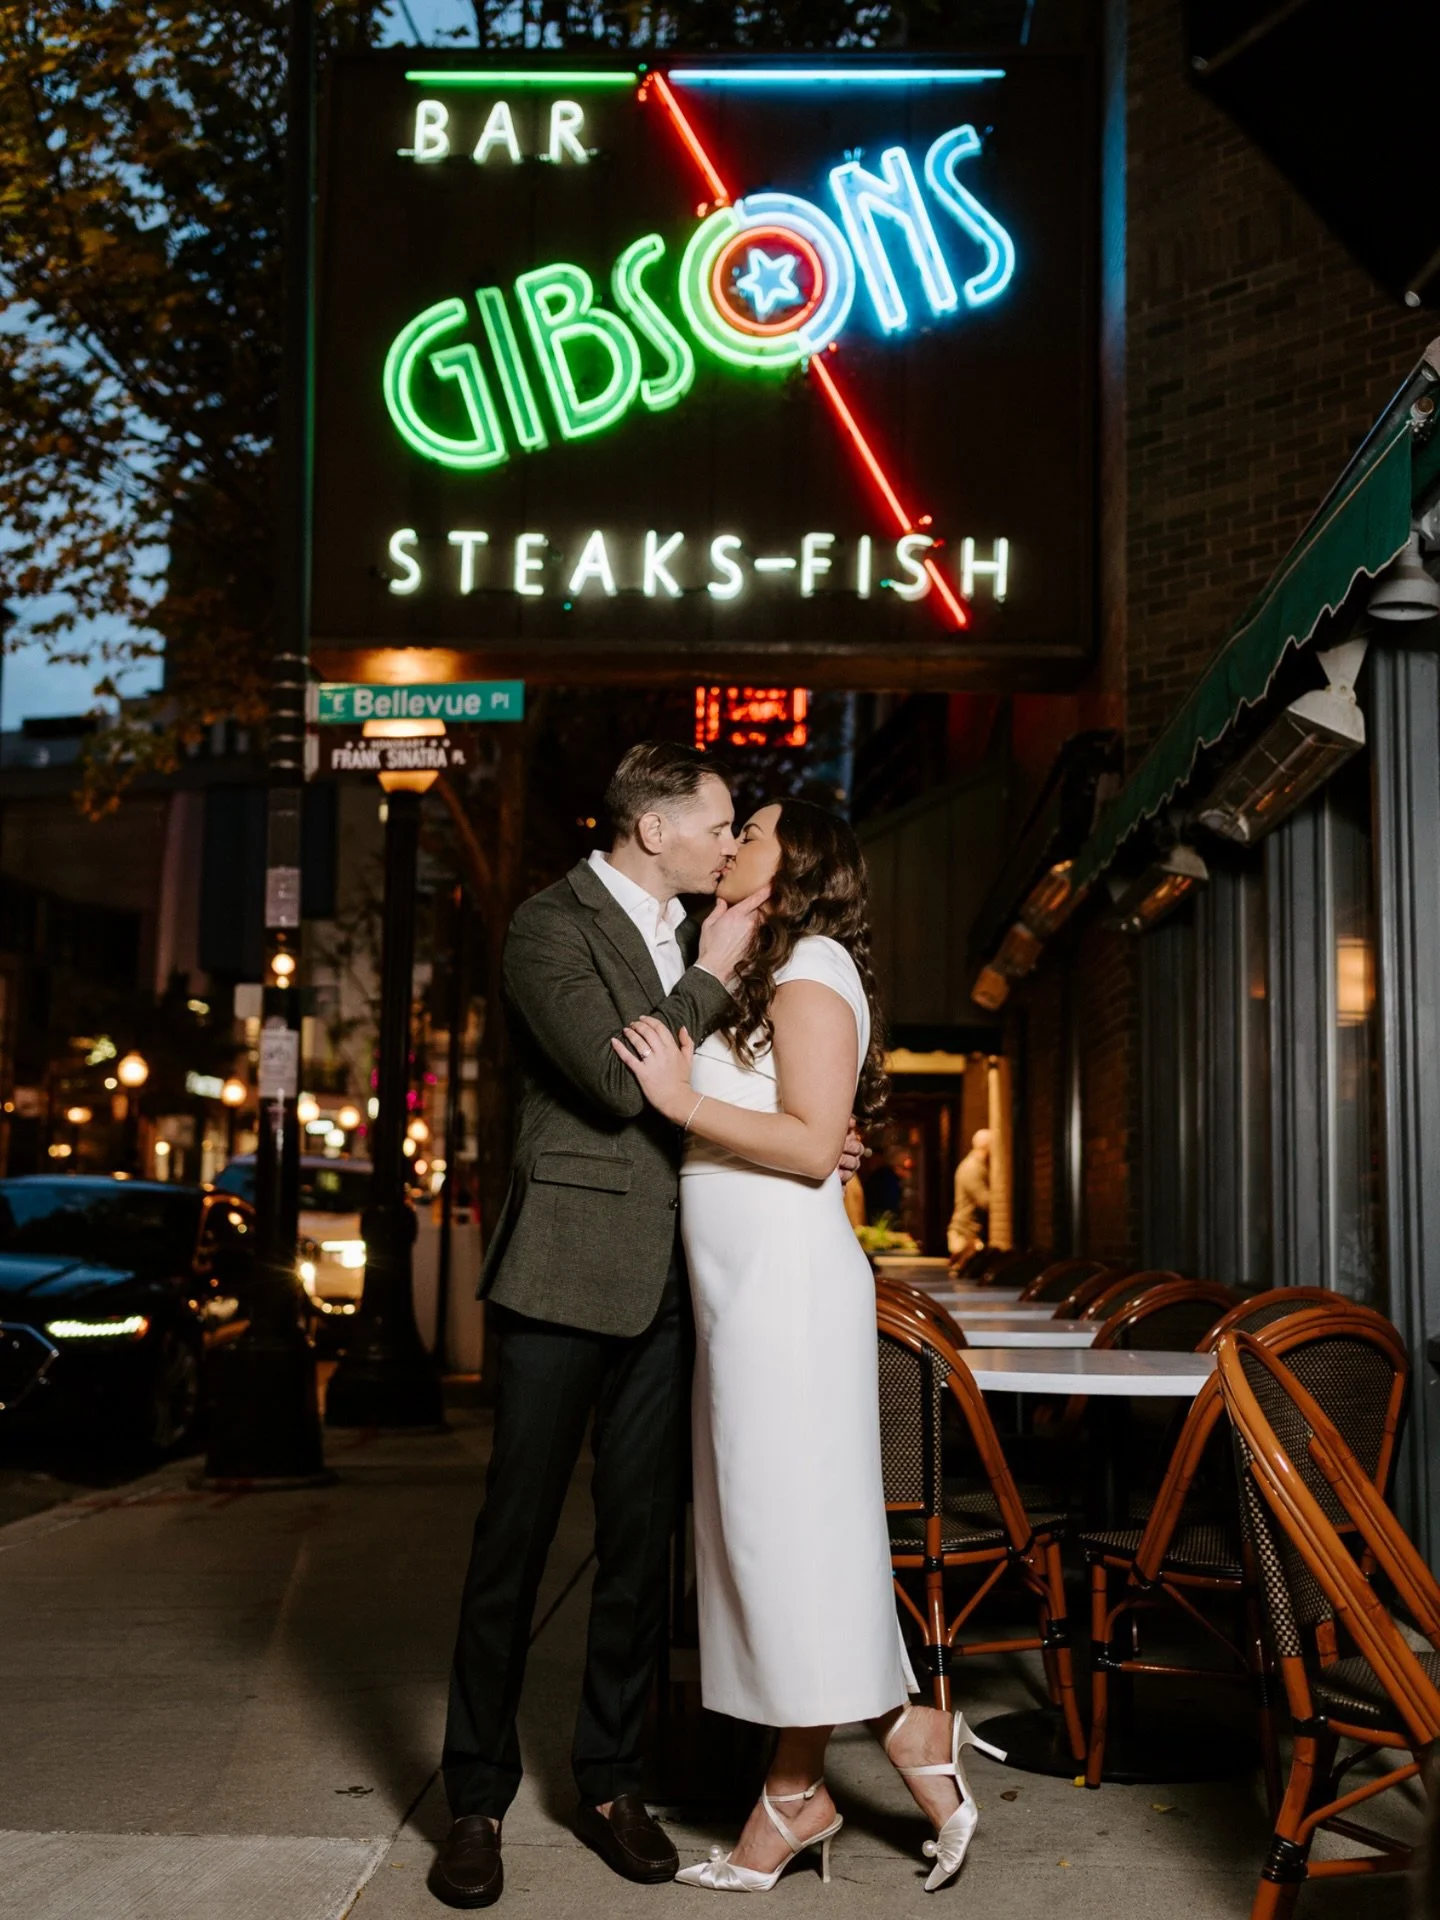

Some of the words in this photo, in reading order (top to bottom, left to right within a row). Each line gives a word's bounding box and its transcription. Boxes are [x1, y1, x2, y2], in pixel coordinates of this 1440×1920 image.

[414, 99, 590, 164] BAR
[383, 124, 1016, 470] GIBSONS
[332, 693, 346, 713] E
[353, 688, 482, 717] Bellevue
[331, 748, 381, 769] FRANK
[386, 747, 448, 769] SINATRA
